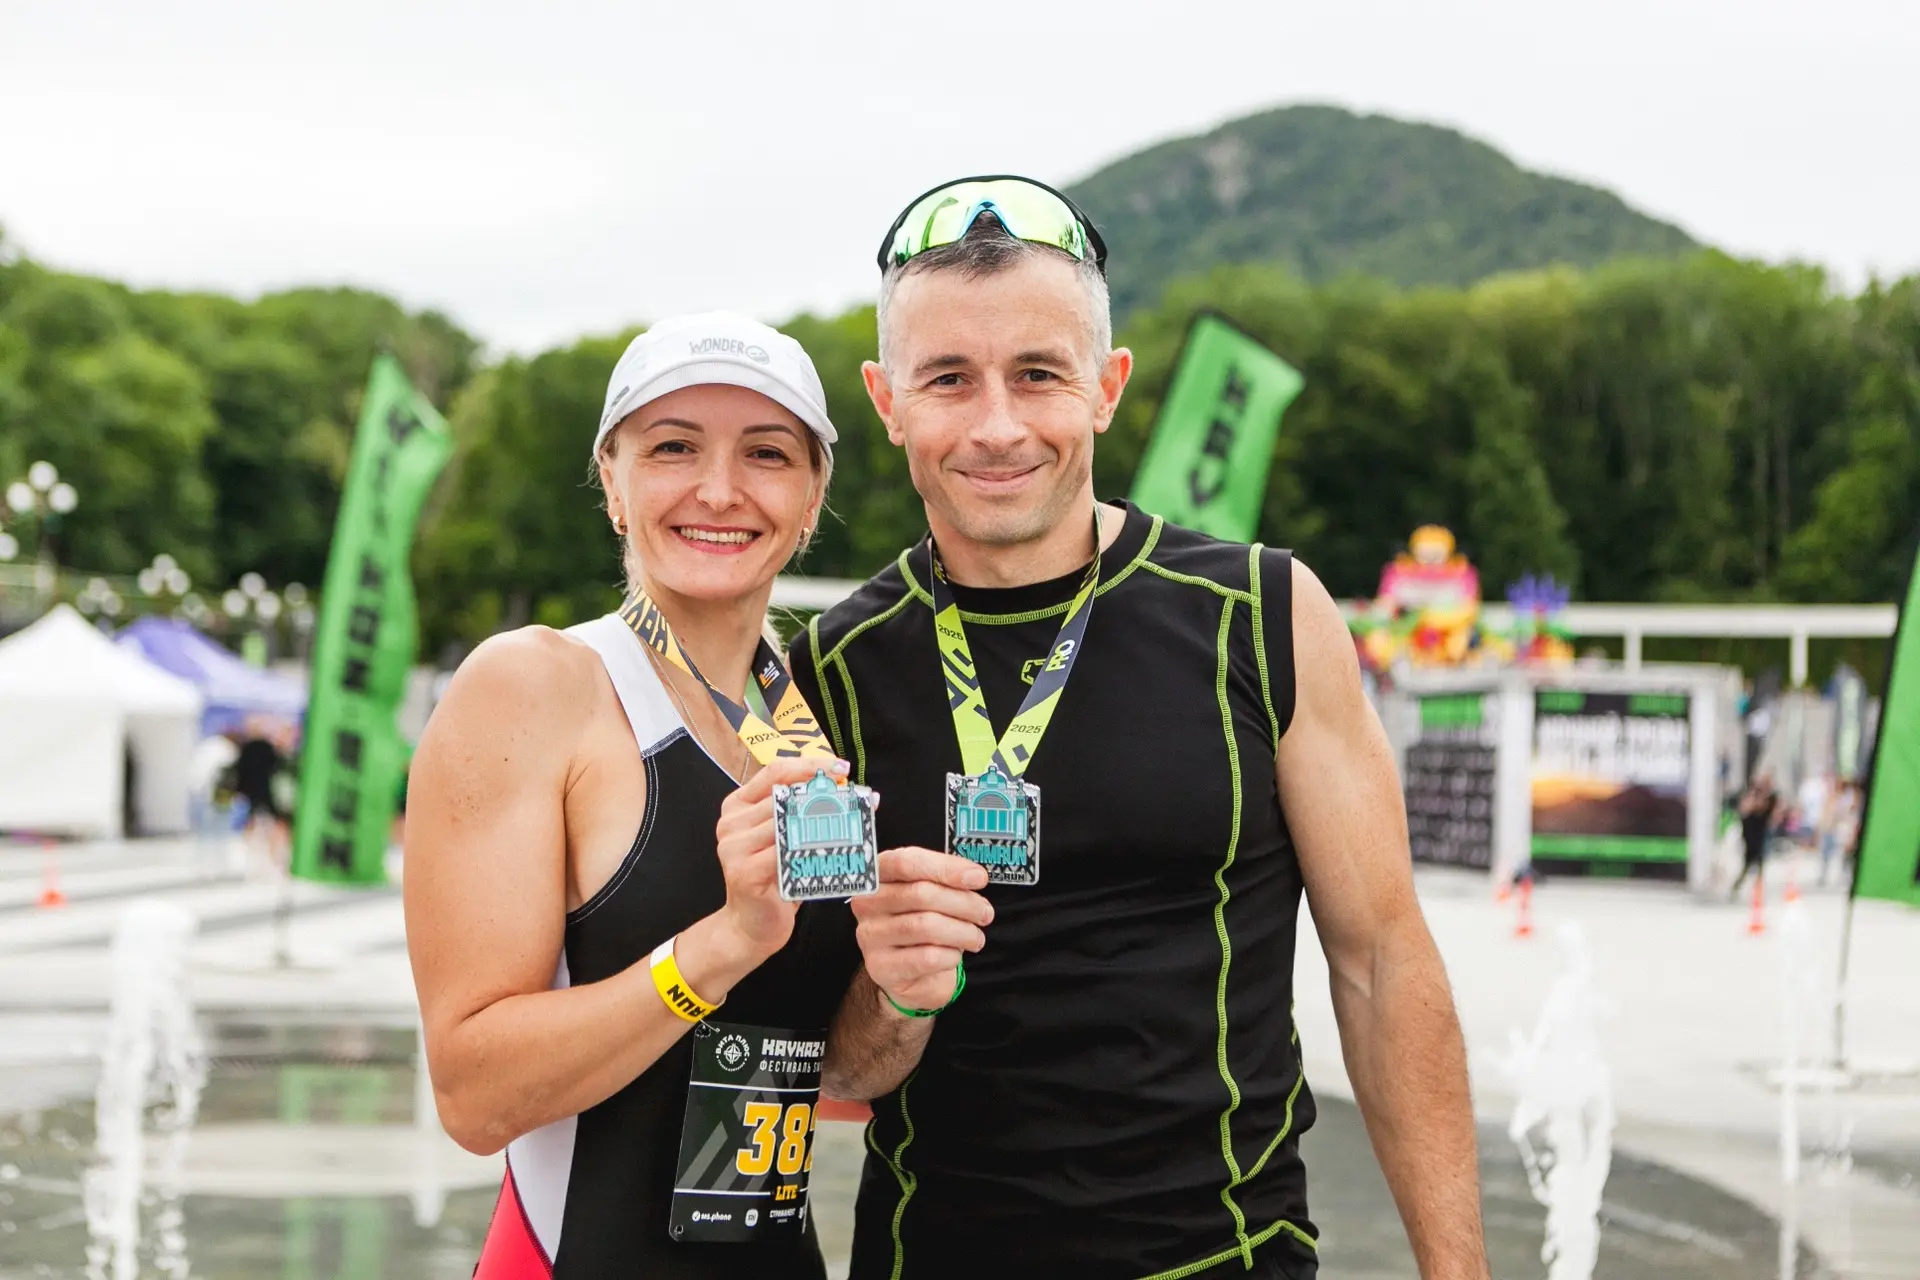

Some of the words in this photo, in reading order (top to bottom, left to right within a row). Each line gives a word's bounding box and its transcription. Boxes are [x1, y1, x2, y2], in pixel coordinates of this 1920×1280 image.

[689, 337, 745, 356] WONDER
[937, 623, 964, 641] 2025
[1044, 639, 1076, 672] PRO
[1010, 723, 1043, 734] 2025
[957, 842, 1027, 866] SWIMRUN
[791, 851, 866, 879] SWIMRUN
[759, 1059, 812, 1074] ФЕСТИВАЛЬ
[736, 1101, 820, 1176] 38
[775, 1184, 798, 1201] LITE
